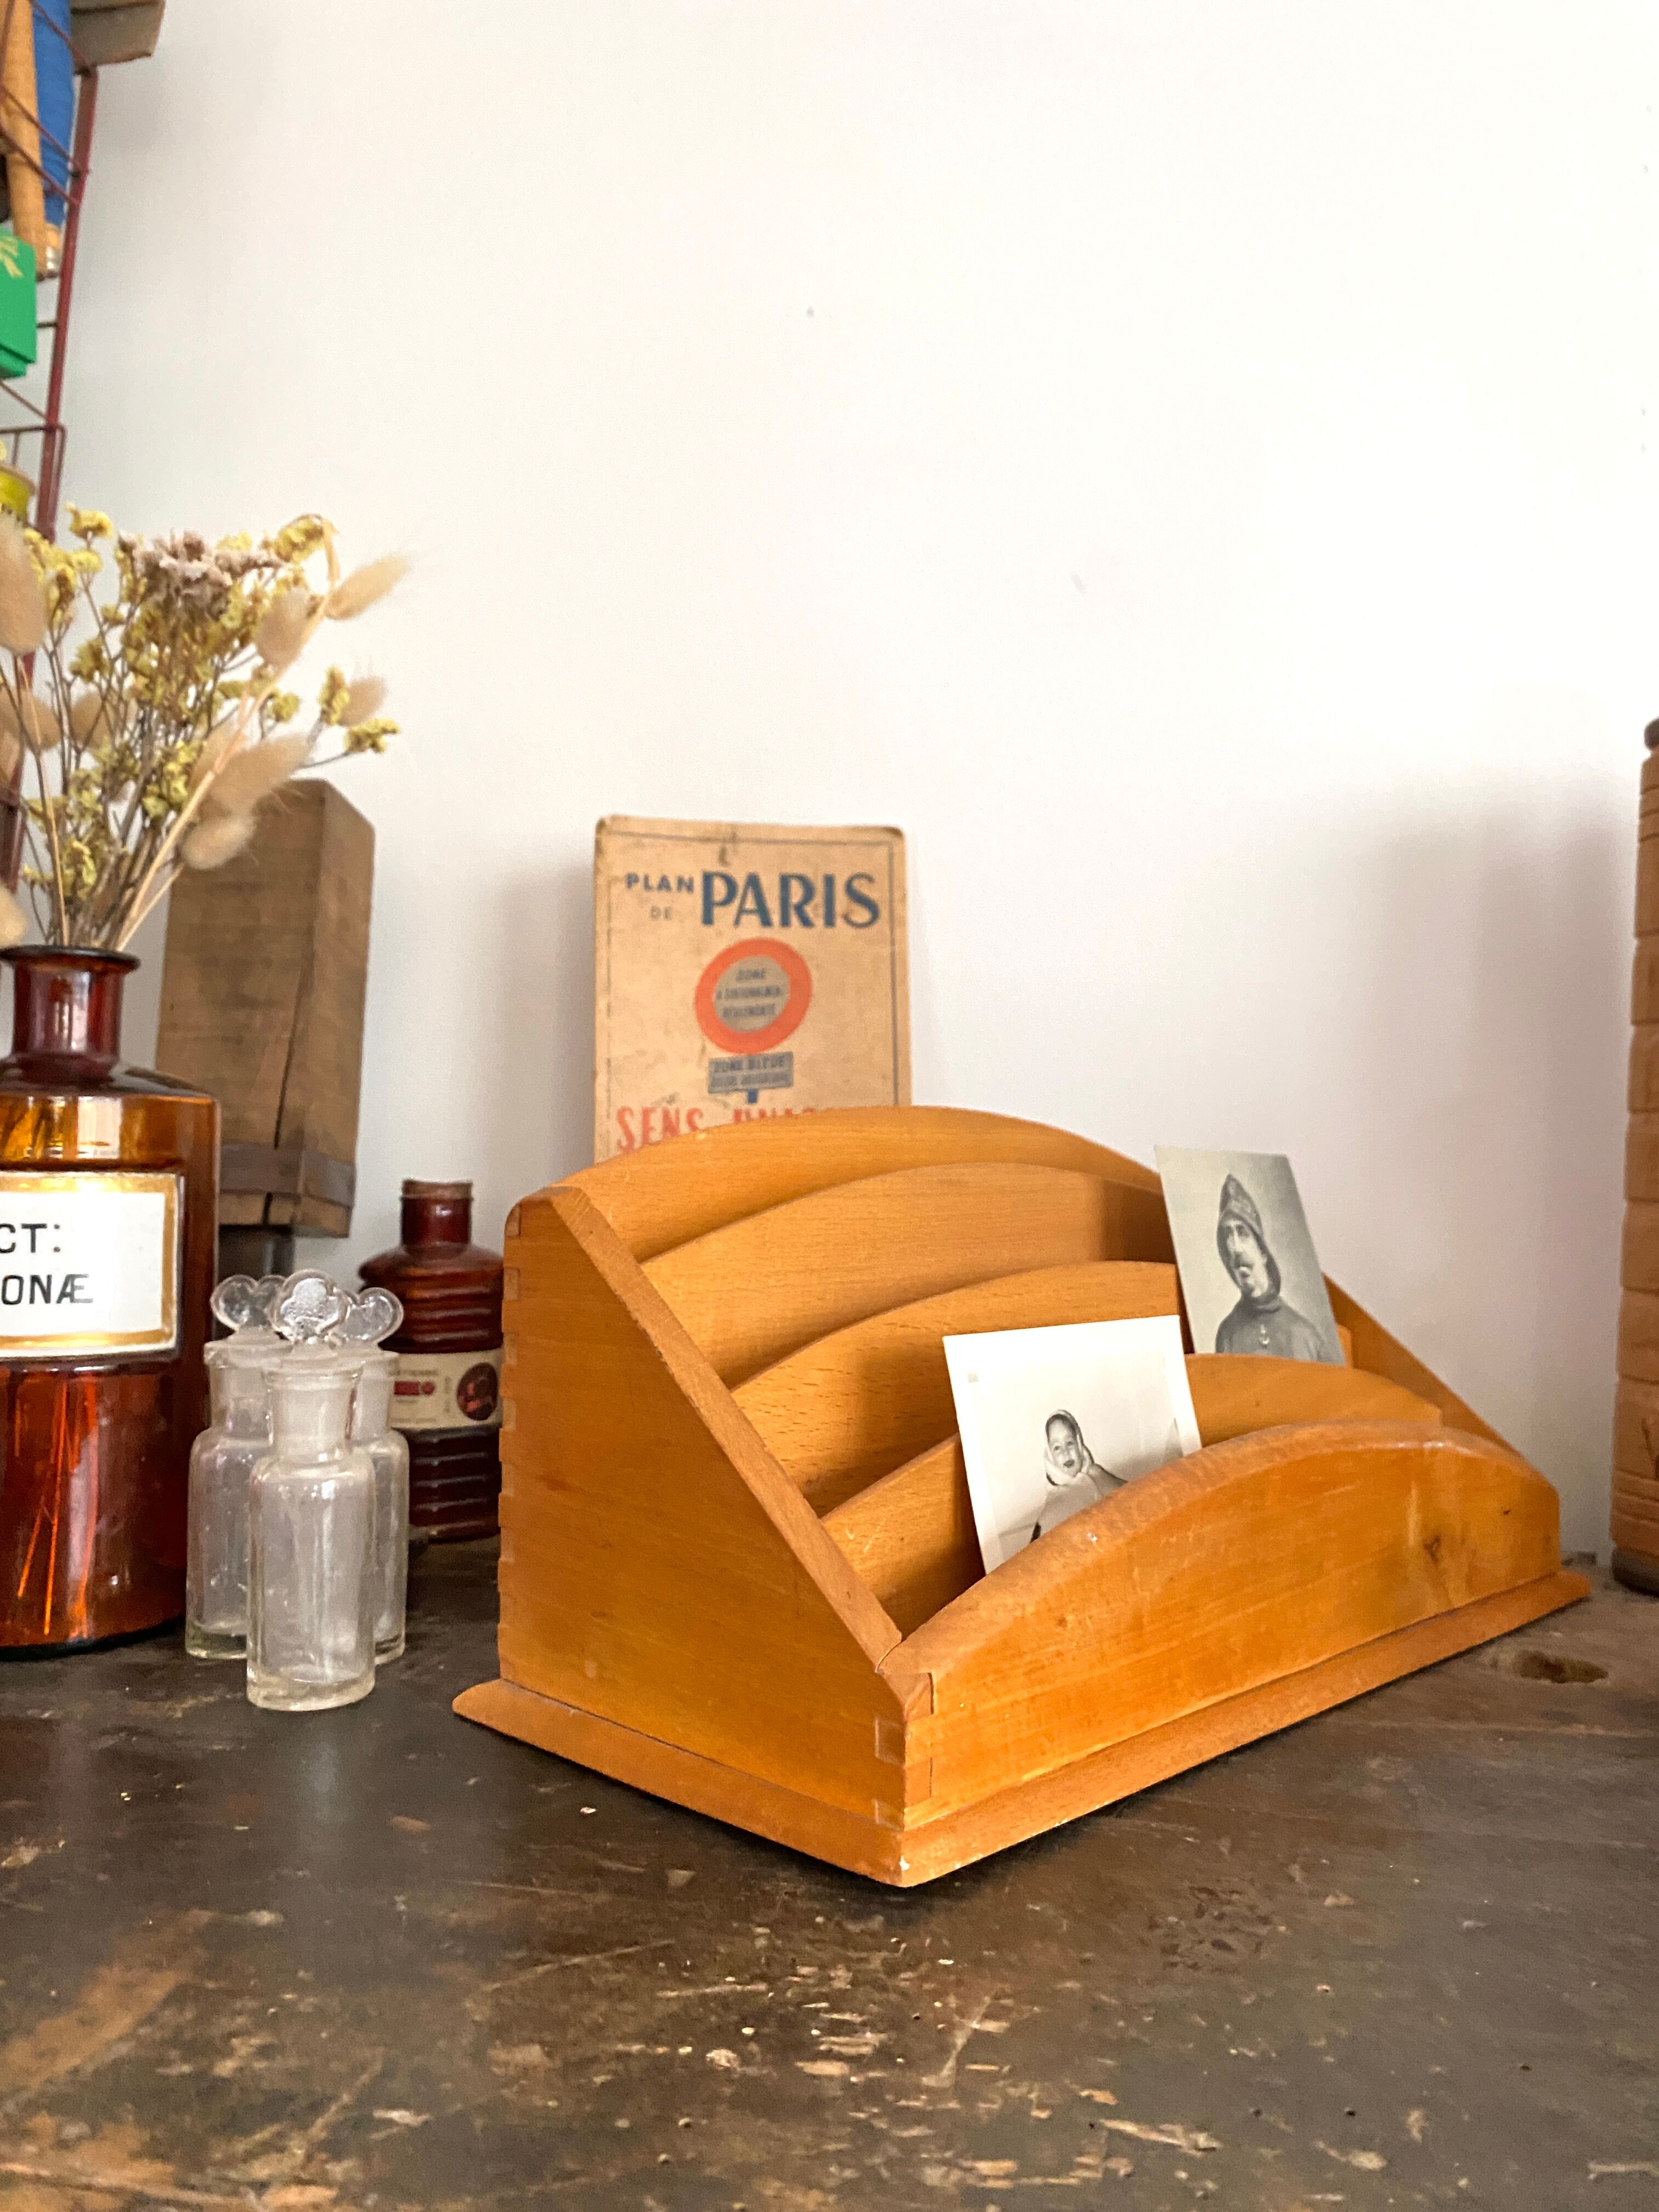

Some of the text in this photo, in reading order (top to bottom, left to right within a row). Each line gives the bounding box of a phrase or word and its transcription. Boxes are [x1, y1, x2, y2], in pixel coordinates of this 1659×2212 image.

[626, 872, 695, 894] PLAN
[650, 905, 673, 921] DE
[701, 871, 879, 929] PARIS
[1, 1274, 93, 1305] ONÆ
